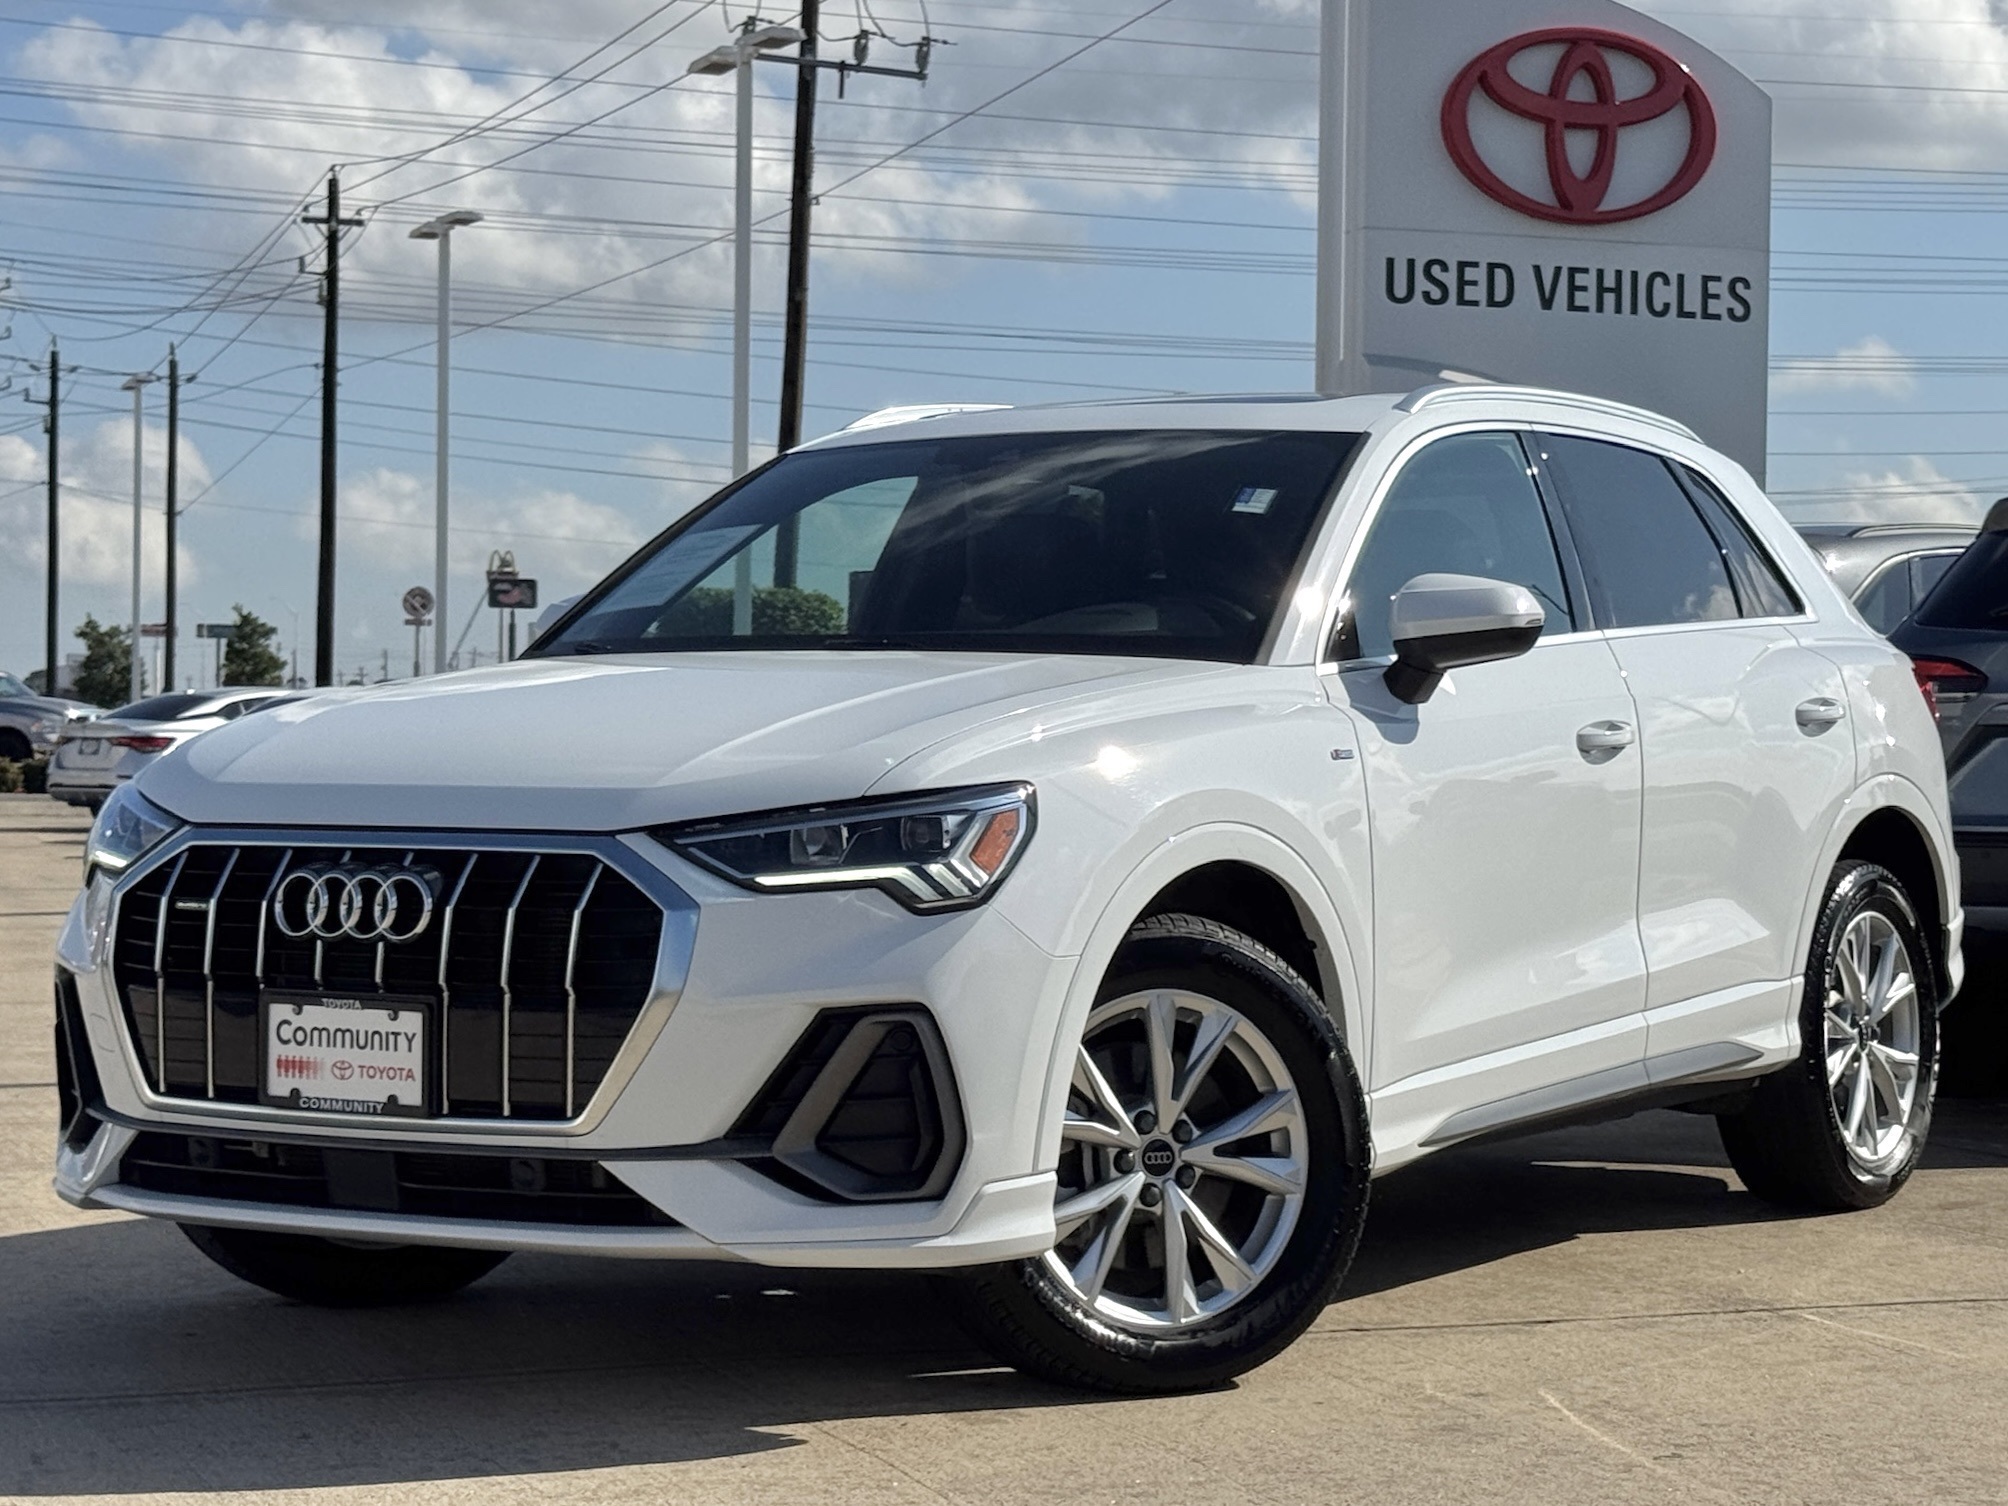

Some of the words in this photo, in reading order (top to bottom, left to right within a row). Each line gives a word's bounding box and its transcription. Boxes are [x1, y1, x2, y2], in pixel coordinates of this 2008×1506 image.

[1385, 257, 1515, 308] USED
[1532, 264, 1752, 323] VEHICLES
[322, 998, 362, 1010] TOYOTA
[358, 1065, 416, 1082] TOYOTA
[300, 1098, 385, 1114] COMMUNITY
